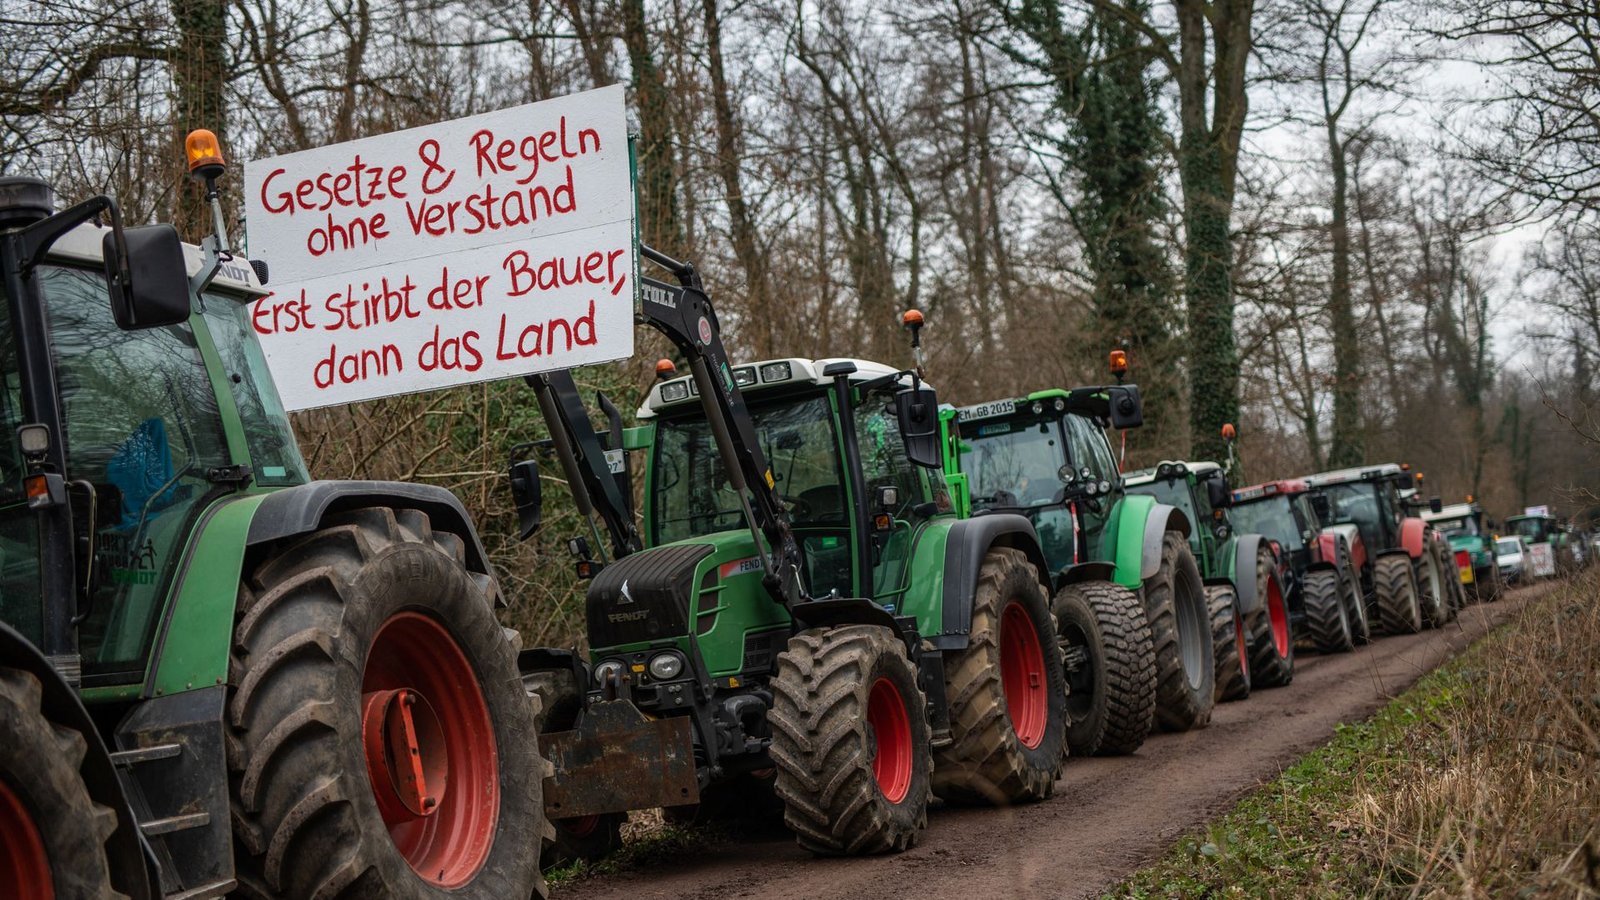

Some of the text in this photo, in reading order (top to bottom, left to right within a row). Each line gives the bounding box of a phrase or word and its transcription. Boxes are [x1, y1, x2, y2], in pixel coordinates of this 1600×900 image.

[261, 116, 600, 214] Gesetze & Regeln
[308, 165, 576, 256] ohne Verstand
[219, 262, 250, 282] NDT
[252, 289, 316, 334] Erst
[427, 268, 490, 310] der
[502, 249, 625, 297] Bauer,
[641, 283, 676, 309] TOLL
[314, 300, 597, 389] dann das Land
[976, 406, 989, 417] GB
[990, 401, 1013, 415] 2015
[608, 609, 649, 623] FENDT
